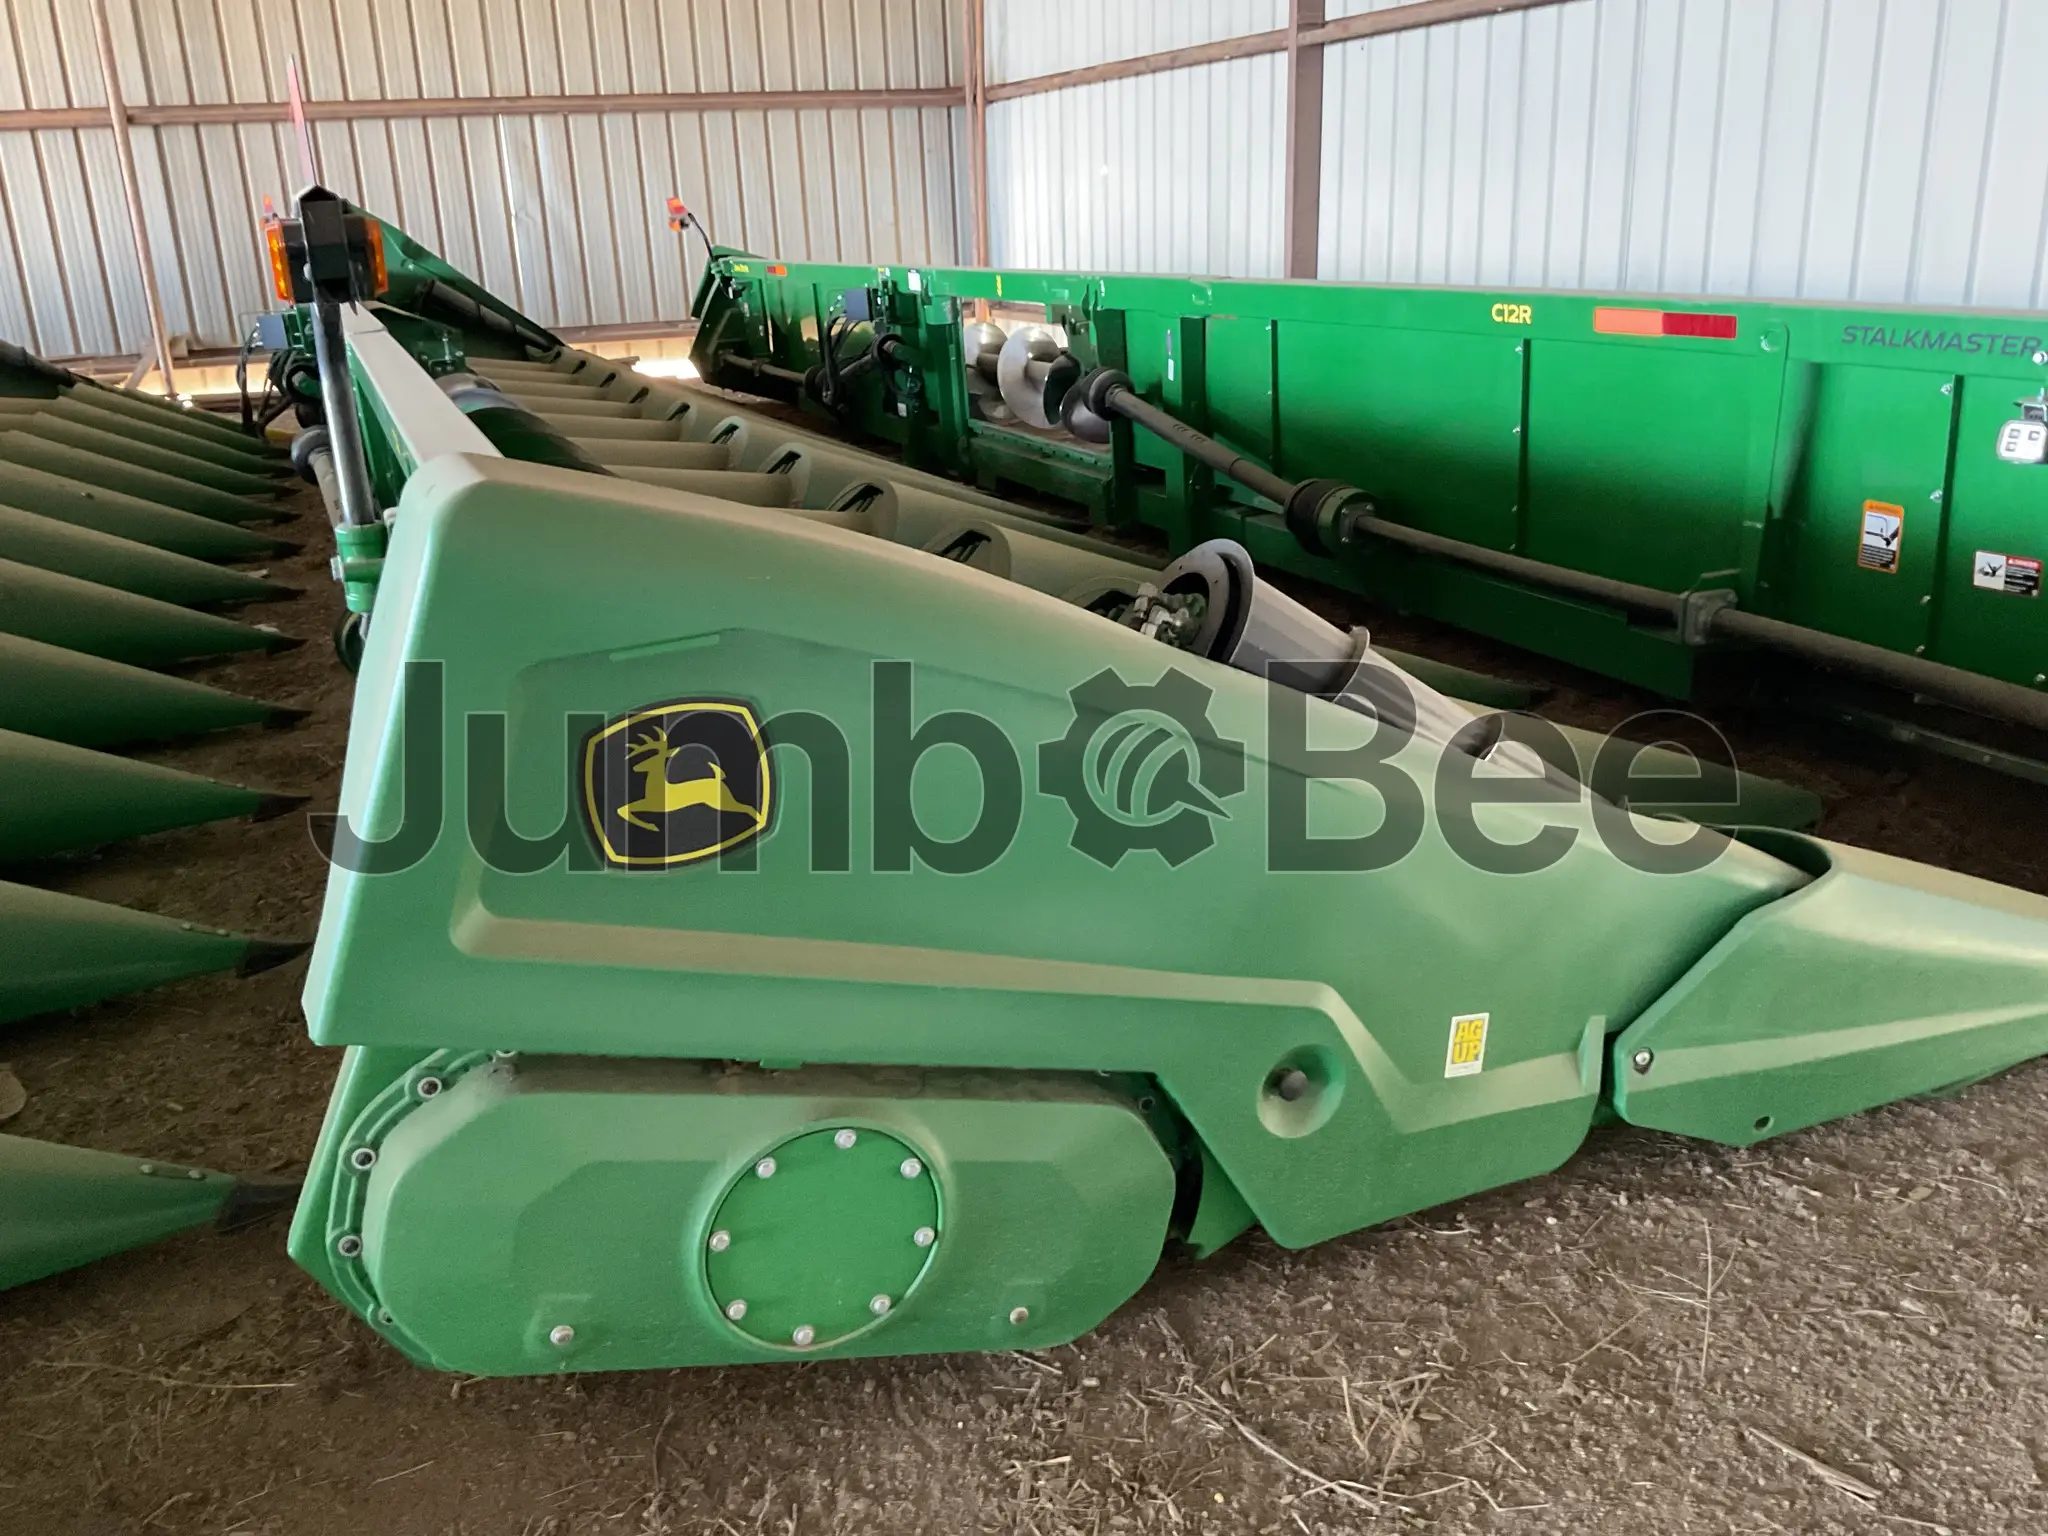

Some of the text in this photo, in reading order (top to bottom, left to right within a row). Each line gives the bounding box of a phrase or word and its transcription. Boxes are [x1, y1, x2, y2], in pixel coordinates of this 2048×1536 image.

[1491, 303, 1532, 325] C12R
[1841, 325, 2043, 357] STALKMASTER
[1454, 1019, 1485, 1042] AG
[1452, 1040, 1482, 1064] UP
